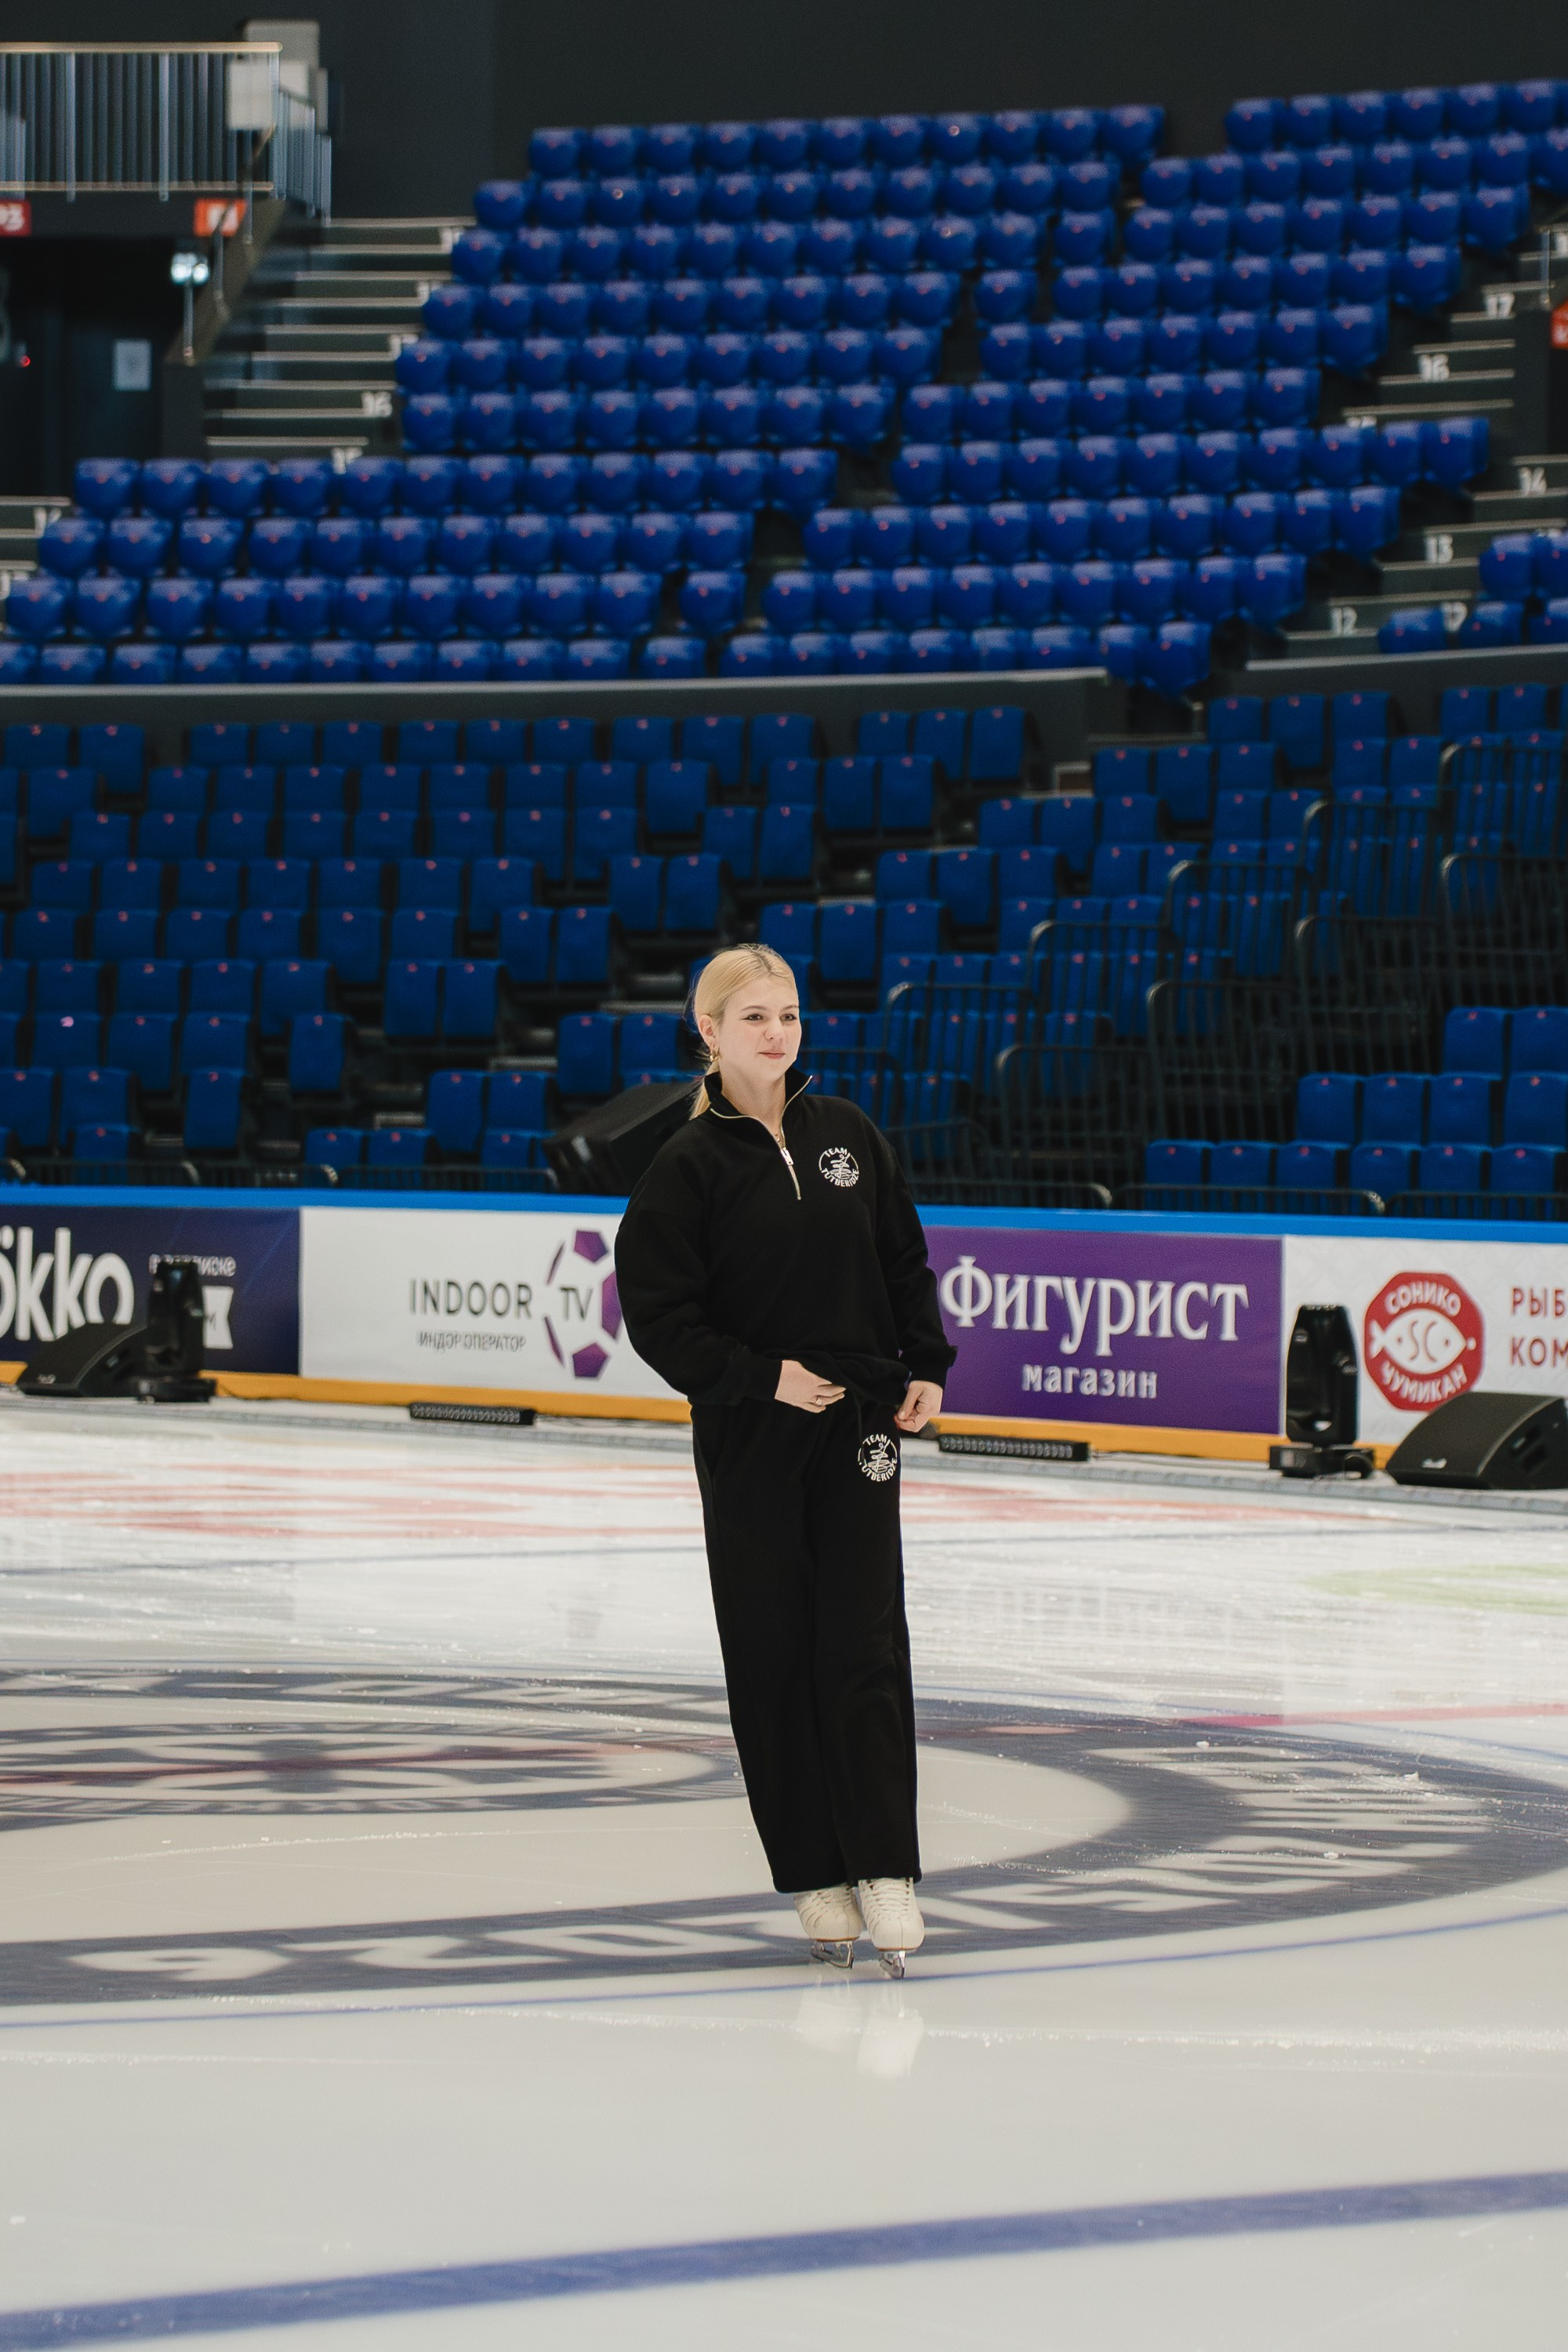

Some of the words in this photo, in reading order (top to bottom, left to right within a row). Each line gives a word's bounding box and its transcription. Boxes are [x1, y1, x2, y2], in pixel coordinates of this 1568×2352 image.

[824, 1147, 848, 1157] TEAM
[409, 1279, 534, 1319] INDOOR
[560, 1287, 593, 1320] TV
[941, 1255, 1249, 1356] Фигурист
[1385, 1280, 1461, 1316] СОНИКО
[1511, 1287, 1565, 1317] РЫБ
[1022, 1364, 1158, 1399] магазин
[1381, 1362, 1468, 1404] ЧУМИКАН
[862, 1434, 887, 1446] TEAM
